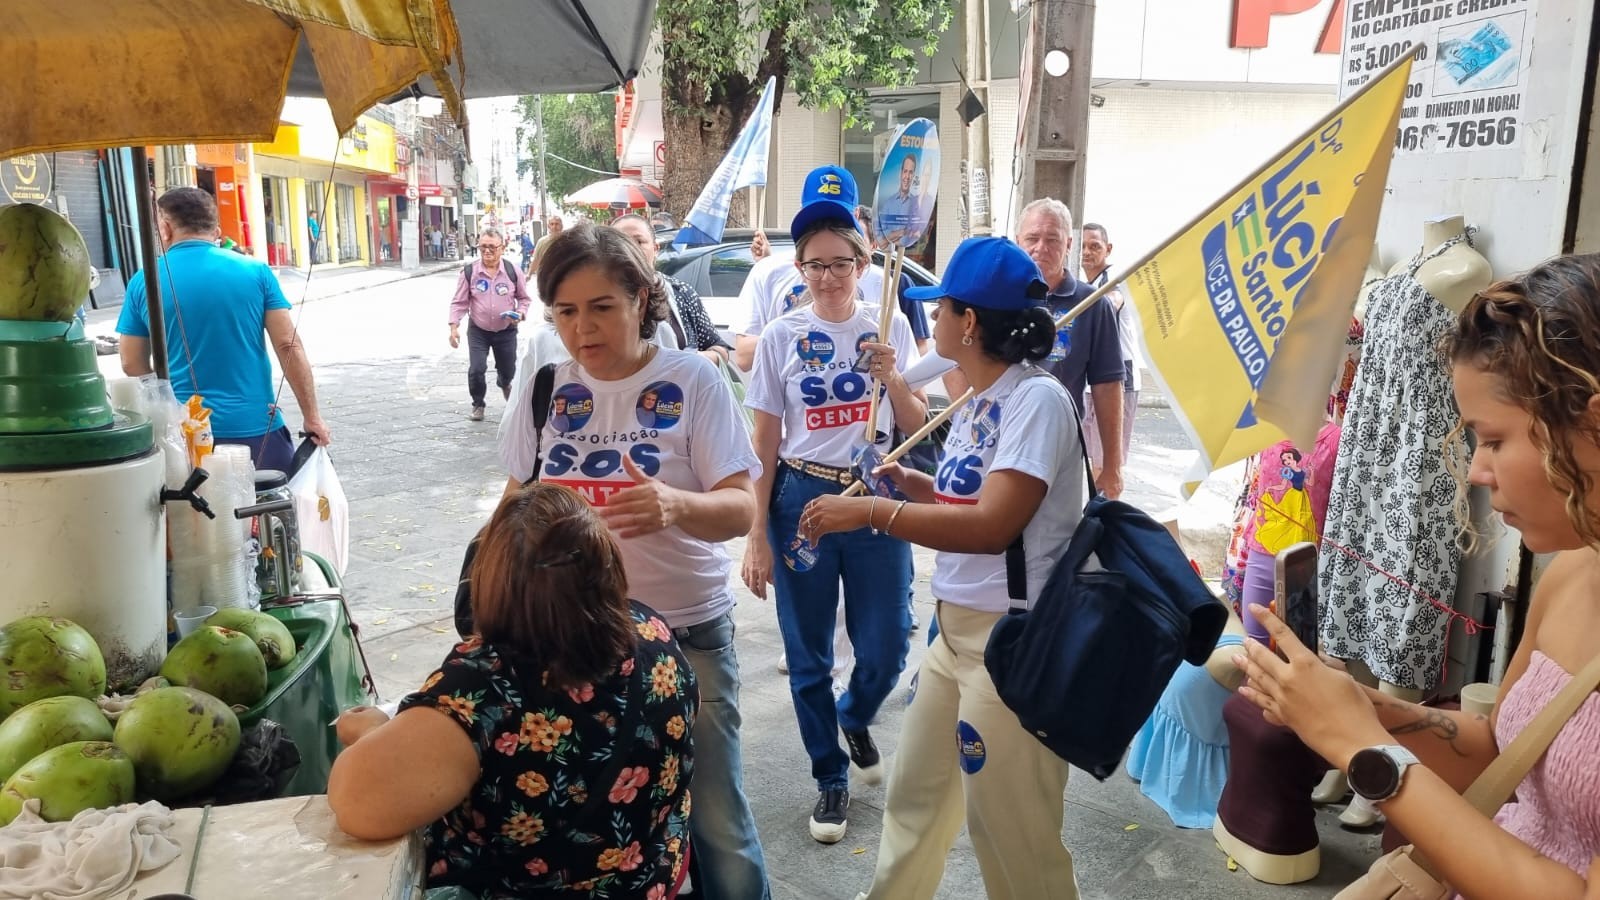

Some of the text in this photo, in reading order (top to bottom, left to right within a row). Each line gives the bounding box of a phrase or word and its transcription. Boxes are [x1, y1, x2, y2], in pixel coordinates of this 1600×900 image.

[1351, 22, 1370, 39] NO
[1372, 8, 1431, 34] CARTÃO
[1432, 3, 1453, 21] DE
[1425, 99, 1471, 119] DINHEIRO
[1471, 98, 1485, 115] NA
[1486, 93, 1521, 113] HORA!
[817, 182, 841, 195] 45
[1207, 248, 1229, 292] VICE
[1214, 287, 1236, 319] DR
[1241, 250, 1287, 351] Santo
[1225, 314, 1266, 376] PAULO
[807, 405, 867, 429] CENT
